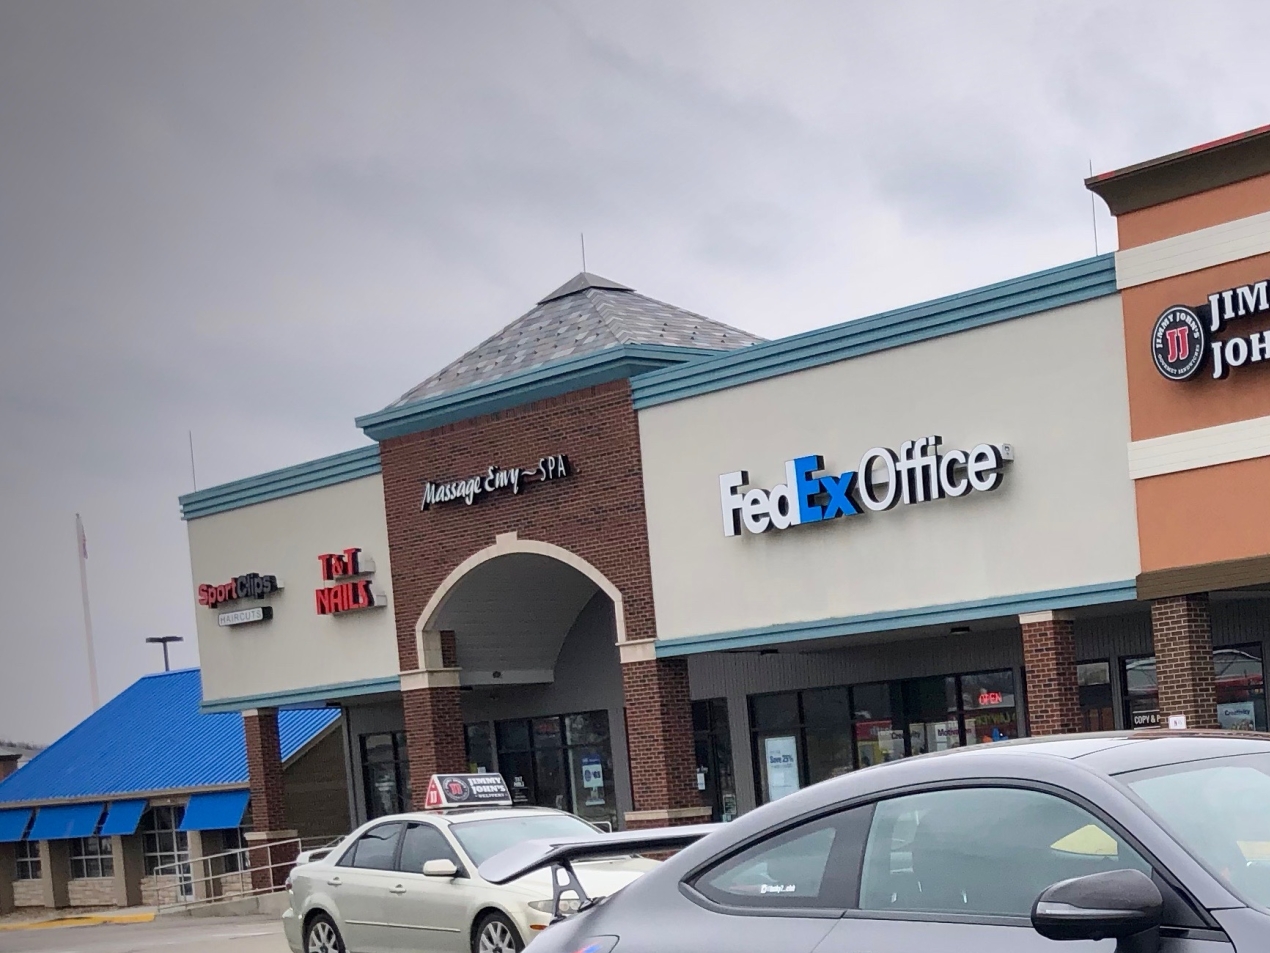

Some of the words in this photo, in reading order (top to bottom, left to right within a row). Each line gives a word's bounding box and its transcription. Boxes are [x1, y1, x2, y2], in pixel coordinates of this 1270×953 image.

[1155, 312, 1174, 349] JIMMY
[1176, 311, 1201, 340] JOHN'S
[1166, 325, 1189, 363] JJ
[420, 481, 483, 512] Massage
[484, 465, 521, 495] Envy
[538, 454, 568, 482] SPA
[719, 453, 859, 538] FedEx
[857, 435, 1002, 512] Office
[317, 548, 361, 581] T&T
[198, 573, 275, 608] SportClips
[315, 580, 372, 615] NAILS
[220, 612, 263, 625] HAIRCUTS
[978, 692, 1003, 706] OPEN
[1134, 715, 1150, 725] COPY
[769, 755, 782, 764] Save
[467, 777, 502, 787] JIMMY
[471, 784, 507, 795] JOHN'S
